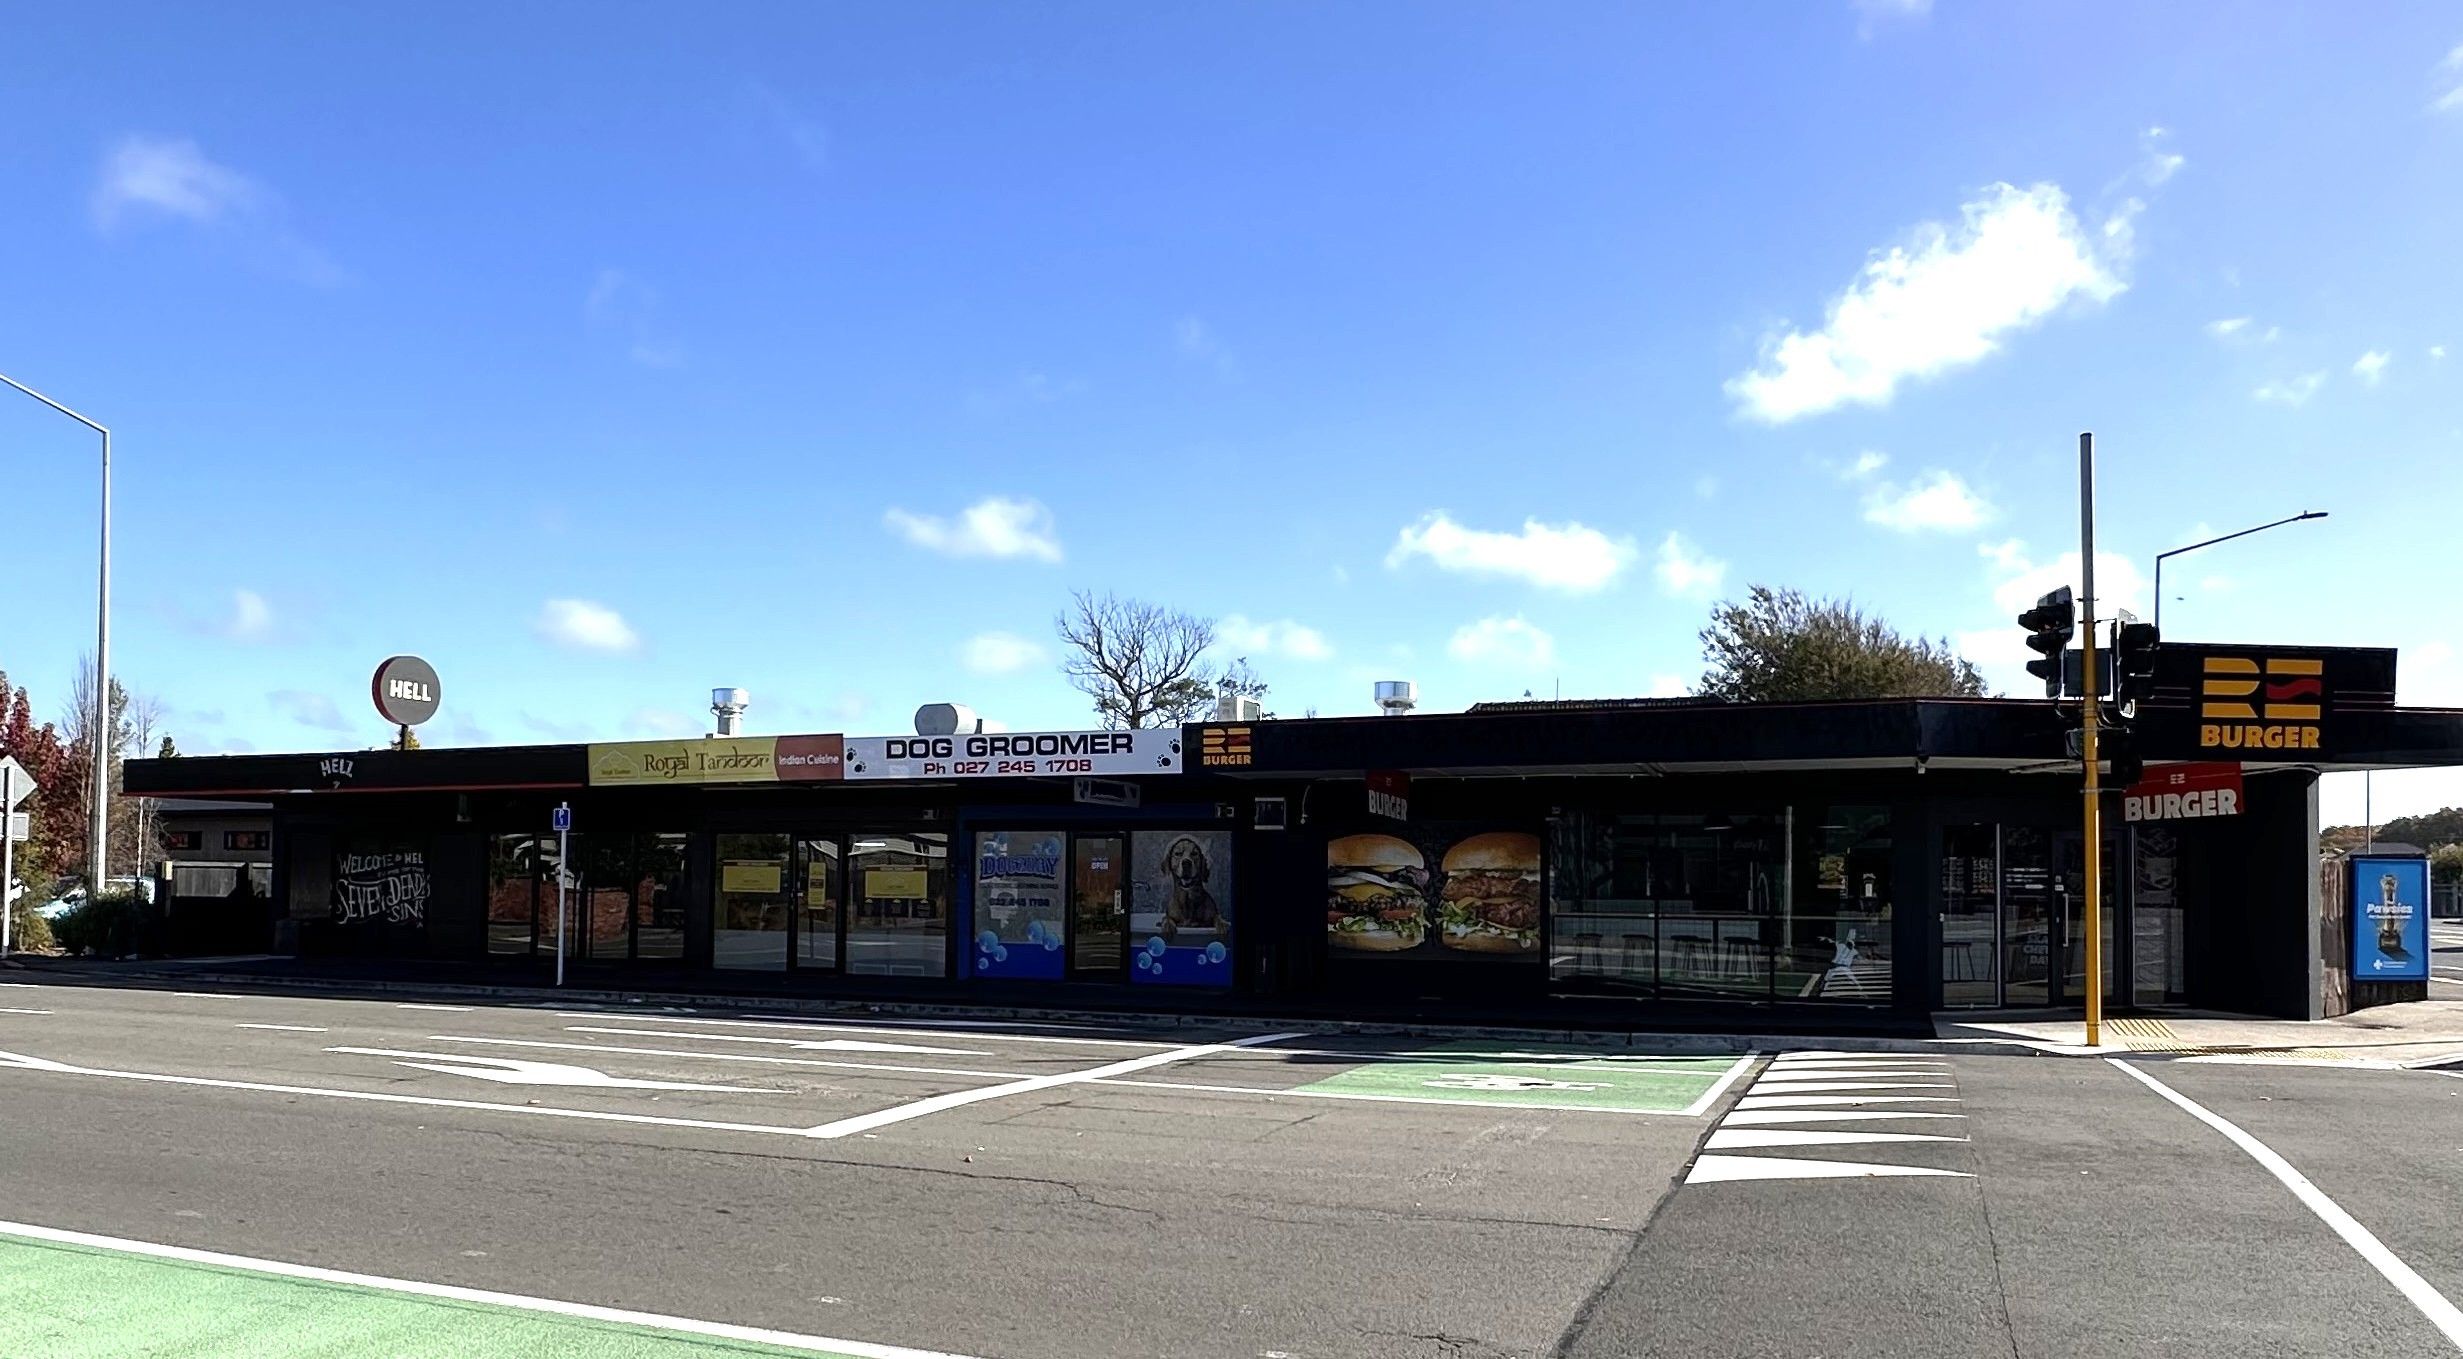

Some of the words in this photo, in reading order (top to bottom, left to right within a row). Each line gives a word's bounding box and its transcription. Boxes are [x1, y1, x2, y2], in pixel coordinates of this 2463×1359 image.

[389, 679, 432, 702] HELL
[886, 738, 953, 759] DOG
[966, 733, 1134, 758] GROOMER
[2200, 724, 2320, 749] BURGER
[643, 748, 689, 779] Royal
[695, 746, 769, 772] Tandoor
[778, 753, 805, 766] Indian
[806, 753, 840, 765] Cuisine
[924, 762, 946, 775] Ph
[953, 761, 989, 774] 027
[997, 760, 1035, 774] 245
[1045, 758, 1092, 773] 1708
[1203, 755, 1251, 766] BURGER
[1368, 789, 1408, 822] BURGER
[2124, 788, 2239, 821] BURGER
